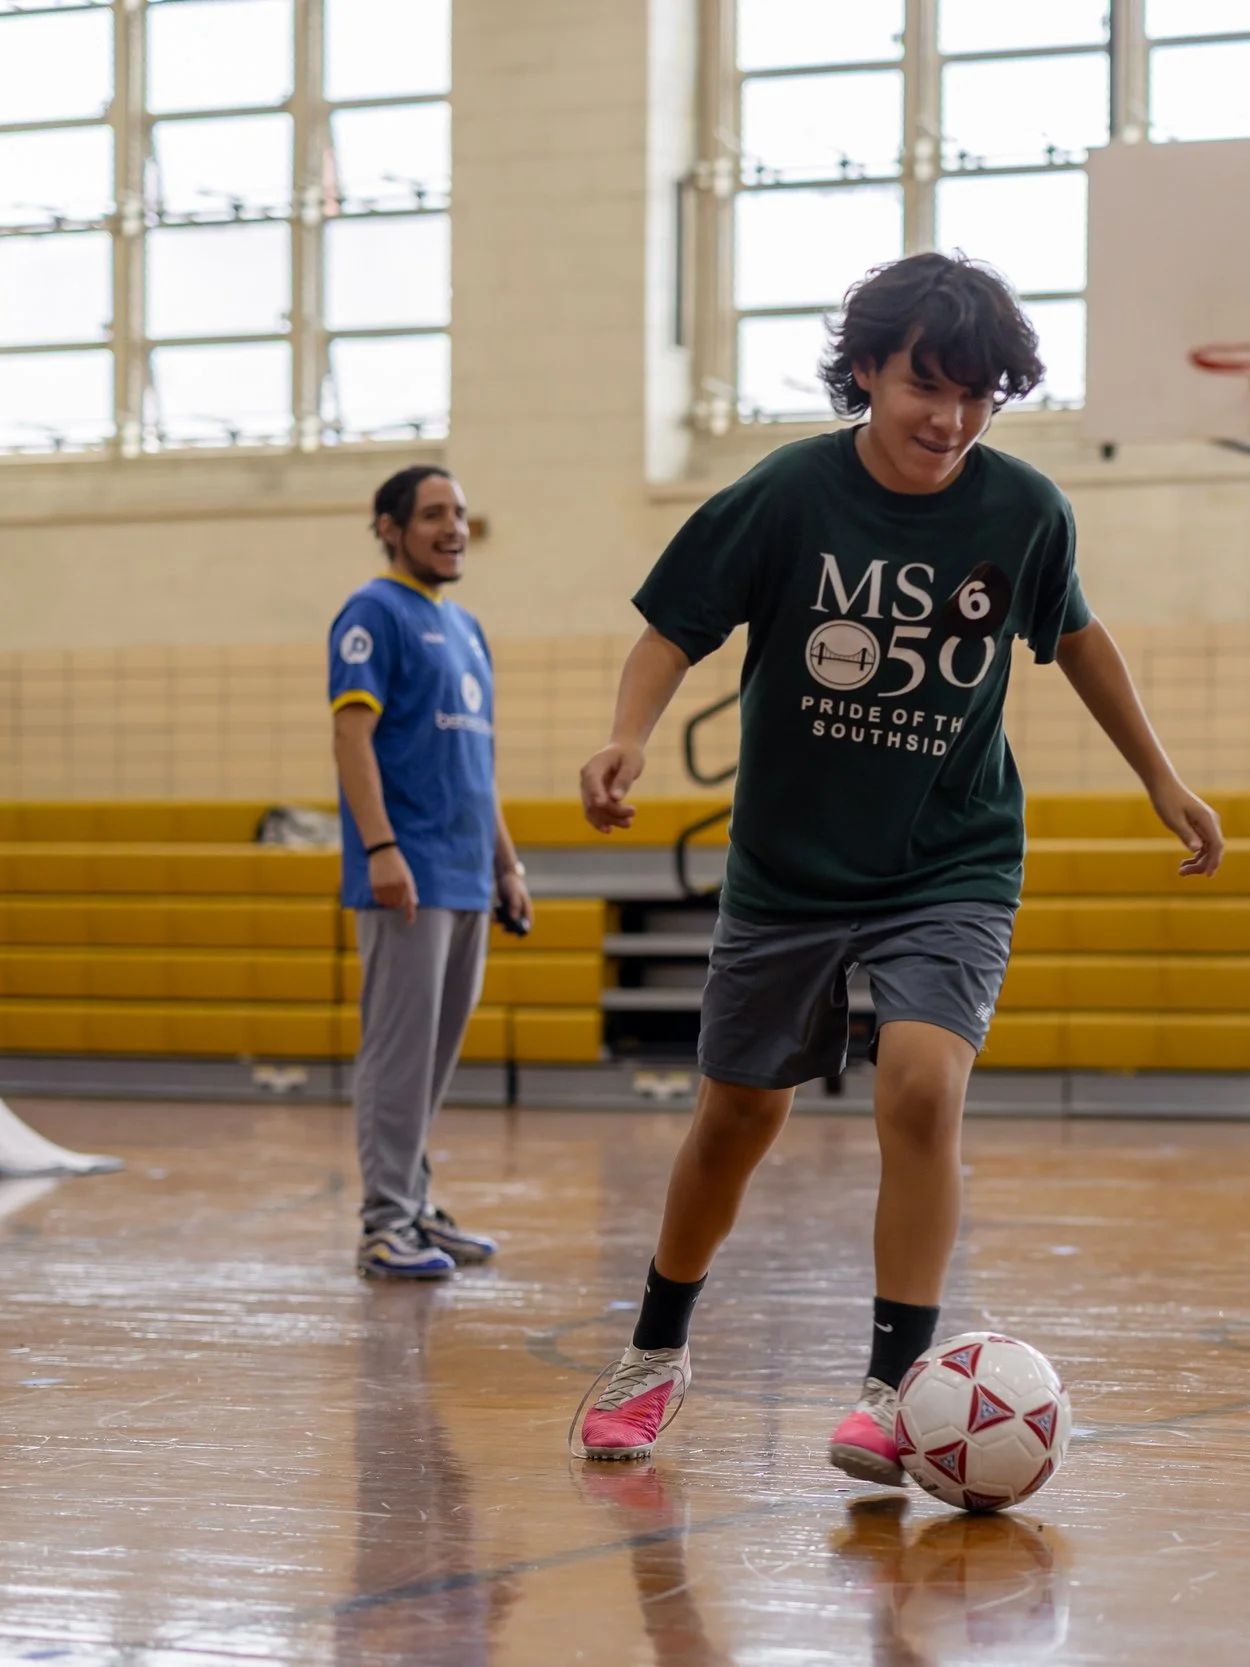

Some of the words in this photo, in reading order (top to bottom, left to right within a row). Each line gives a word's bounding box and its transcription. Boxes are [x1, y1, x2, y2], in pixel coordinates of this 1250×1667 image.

[809, 552, 935, 622] MS
[958, 580, 991, 620] 6
[801, 695, 882, 723] PRIDE
[892, 708, 925, 728] OF
[934, 714, 964, 734] TH
[812, 719, 948, 757] SOUTHSID
